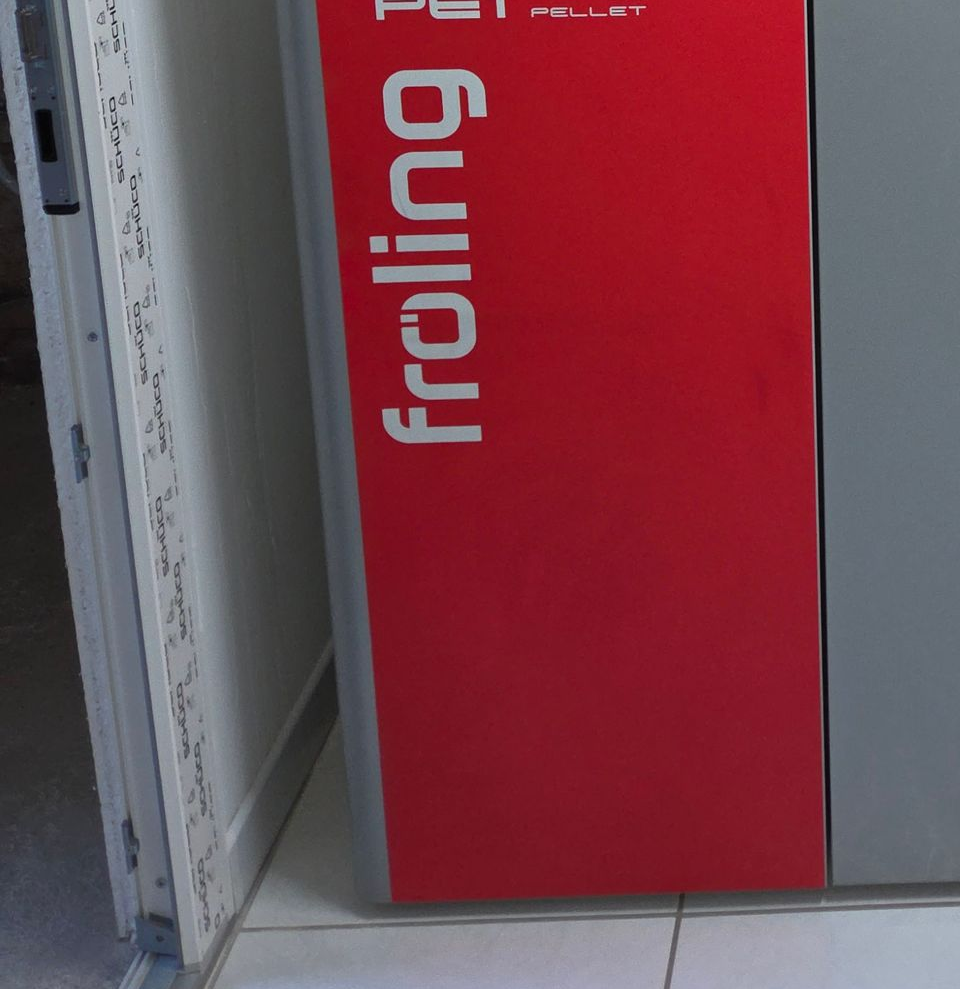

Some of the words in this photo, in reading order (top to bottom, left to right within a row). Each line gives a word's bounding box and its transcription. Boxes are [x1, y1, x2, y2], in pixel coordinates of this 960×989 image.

[530, 5, 647, 18] PELLET
[108, 96, 125, 184] SCHÜCO
[129, 175, 145, 259] SCHÜCO
[132, 302, 148, 385] SCHÜCO
[152, 373, 167, 454] SCHÜCO
[155, 496, 170, 577] SCHÜCO
[173, 562, 188, 640] SCHÜCO
